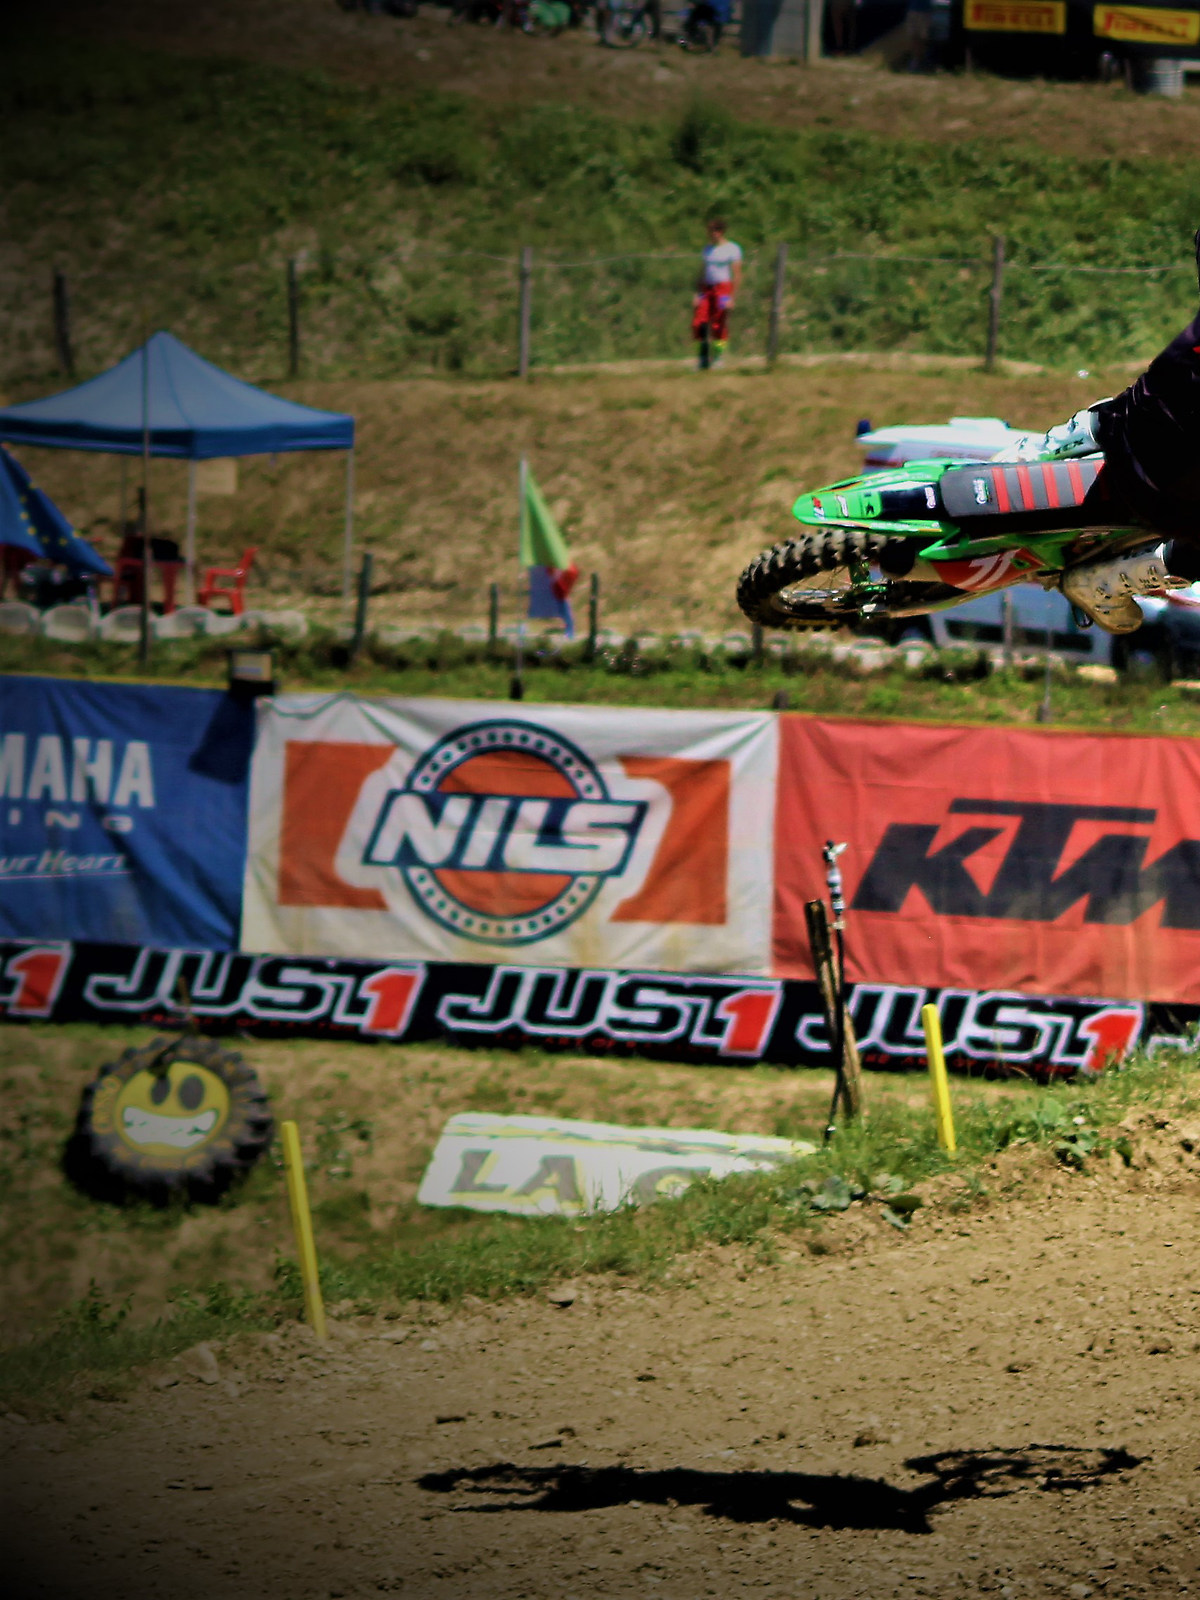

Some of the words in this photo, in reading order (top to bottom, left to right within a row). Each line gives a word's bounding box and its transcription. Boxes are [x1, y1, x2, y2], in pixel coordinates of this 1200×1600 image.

[365, 790, 643, 875] NILS
[84, 946, 428, 1038] JUST1
[436, 965, 783, 1058] JUST1
[452, 1148, 583, 1205] LA
